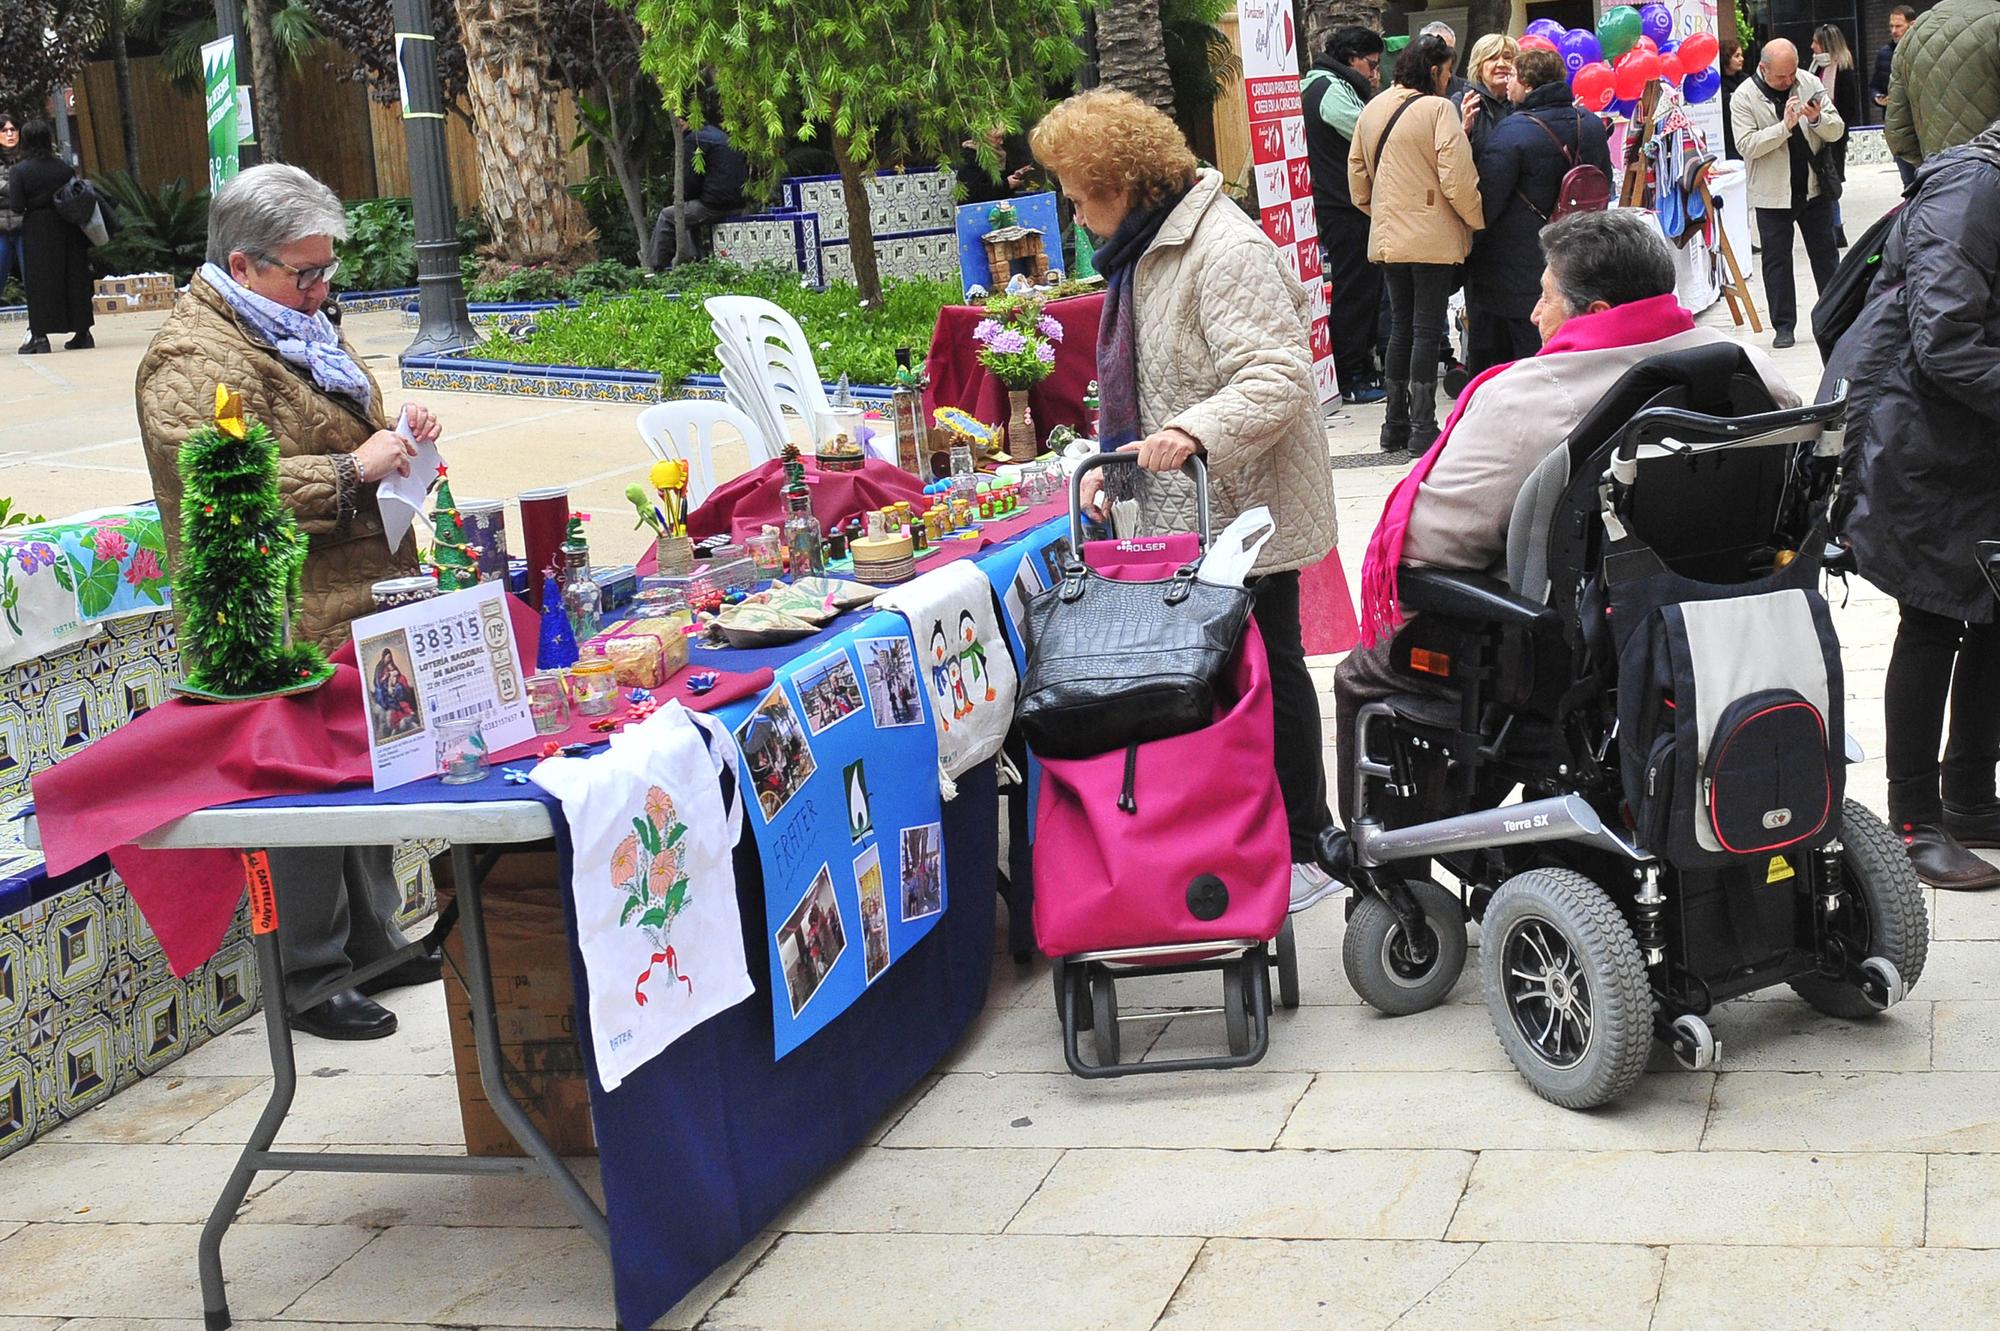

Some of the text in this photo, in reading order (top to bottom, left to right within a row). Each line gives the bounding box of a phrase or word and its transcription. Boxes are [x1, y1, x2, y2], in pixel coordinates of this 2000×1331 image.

[1126, 542, 1167, 552] ROLSER
[413, 617, 479, 654] 38315
[418, 656, 449, 672] LOTERÍA
[450, 646, 485, 662] NACIONAL
[433, 659, 476, 679] DE NAVIDAD
[501, 678, 512, 691] 20
[1503, 813, 1549, 833] Terra SX
[773, 799, 818, 879] FRATER
[255, 868, 273, 930] CASTELLANO
